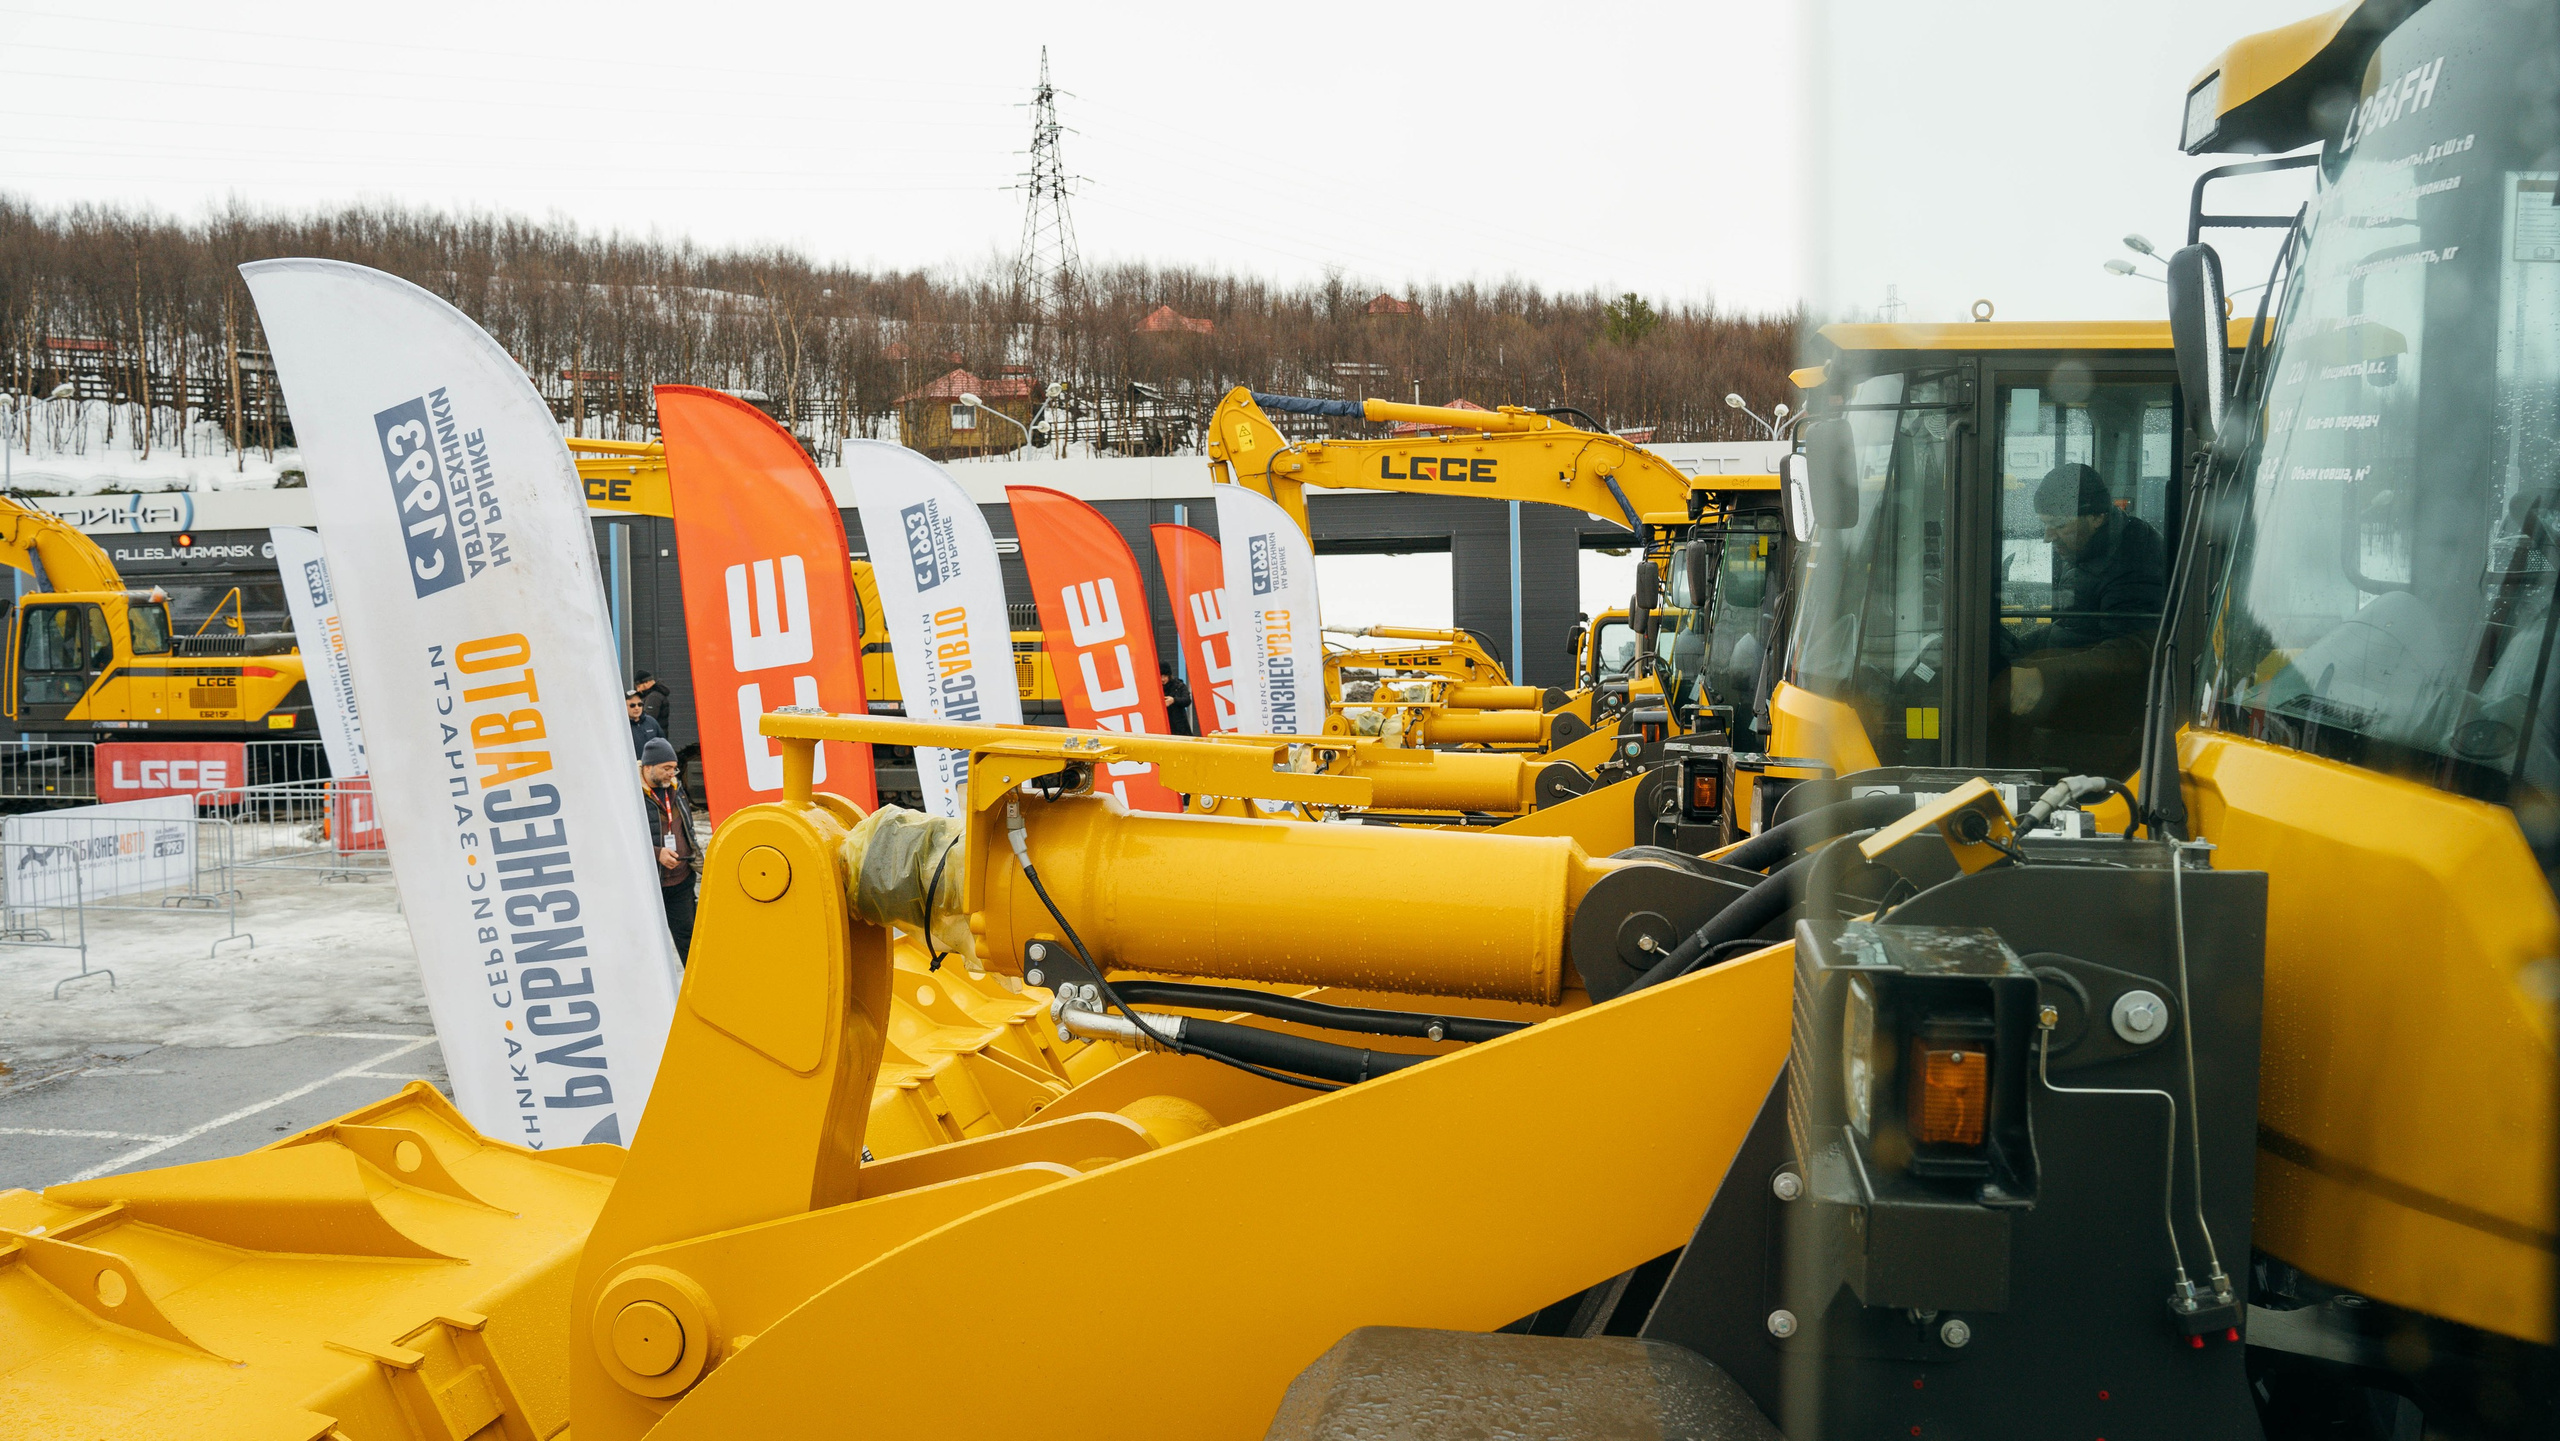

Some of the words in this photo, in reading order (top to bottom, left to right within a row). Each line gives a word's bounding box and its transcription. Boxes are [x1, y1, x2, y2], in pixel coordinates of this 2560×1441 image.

[2338, 56, 2445, 154] L956FH
[2319, 363, 2363, 381] Мощность
[2305, 416, 2334, 431] Кол-во
[2335, 414, 2380, 431] передач
[51, 506, 179, 527] ОЙКА
[115, 545, 255, 561] ALLES_MURMANSK
[112, 760, 228, 790] LGCE
